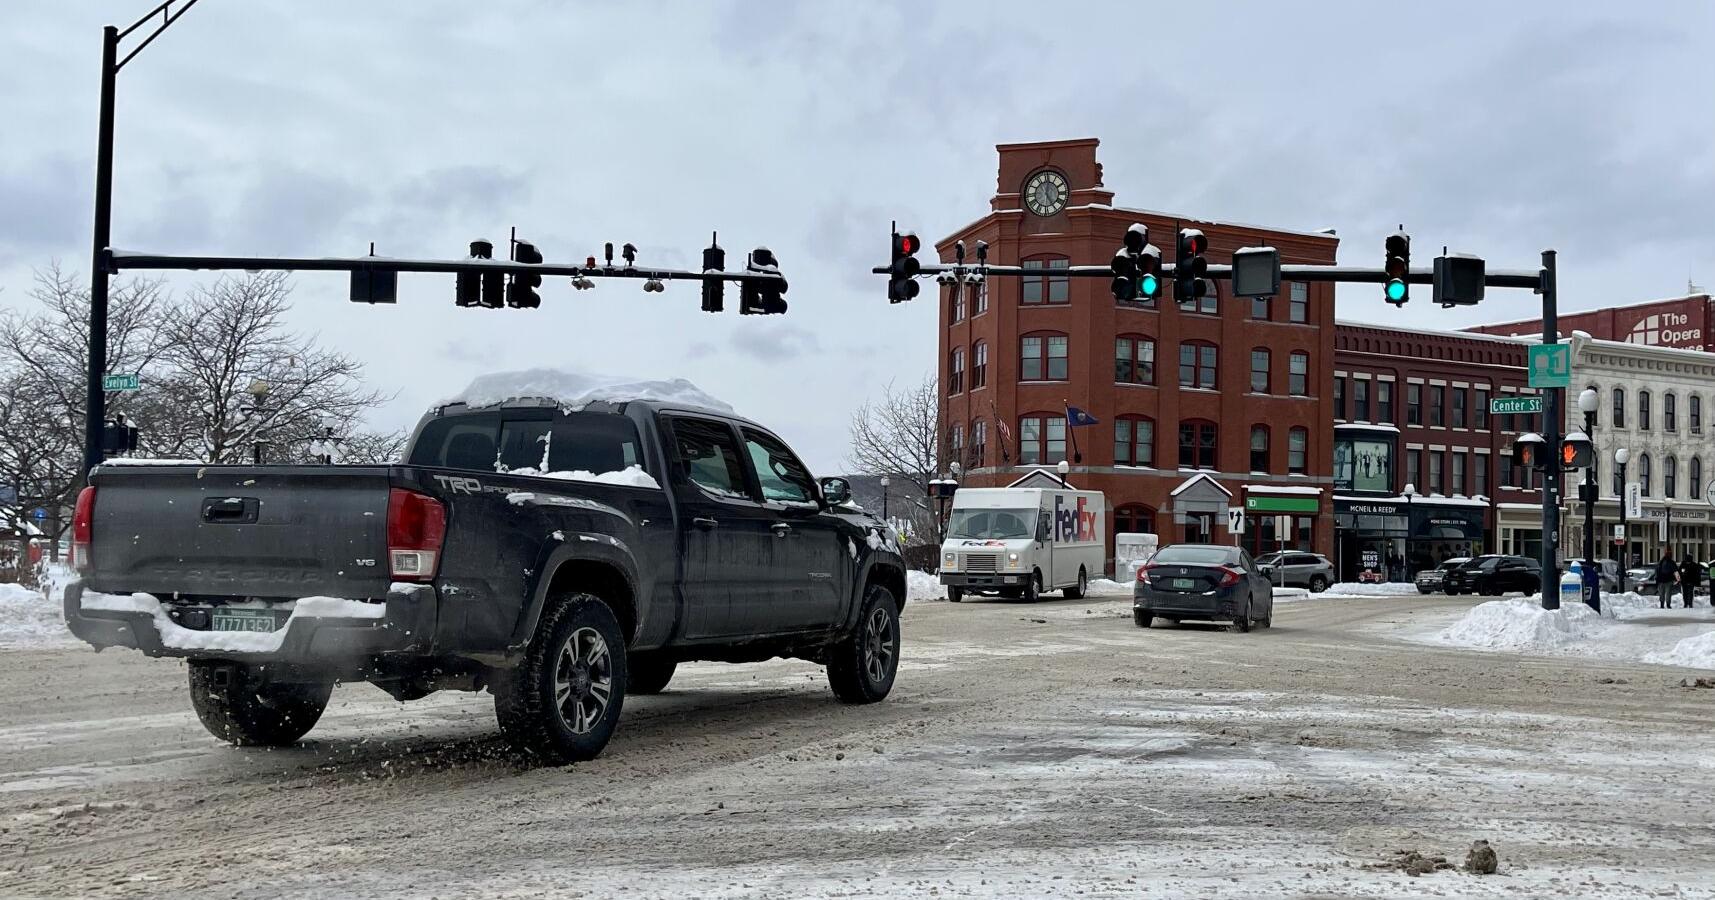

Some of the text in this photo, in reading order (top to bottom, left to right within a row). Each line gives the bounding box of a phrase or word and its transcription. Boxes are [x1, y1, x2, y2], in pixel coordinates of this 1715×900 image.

[1662, 313, 1688, 327] The
[1661, 328, 1701, 344] Opera
[105, 376, 137, 388] Evelyn St
[1493, 400, 1540, 412] Center St
[433, 474, 520, 495] TRD SPORT
[1350, 505, 1372, 513] MCNEIL
[1378, 506, 1397, 514] REEDY
[1055, 495, 1097, 543] FedEx
[355, 558, 376, 566] V6
